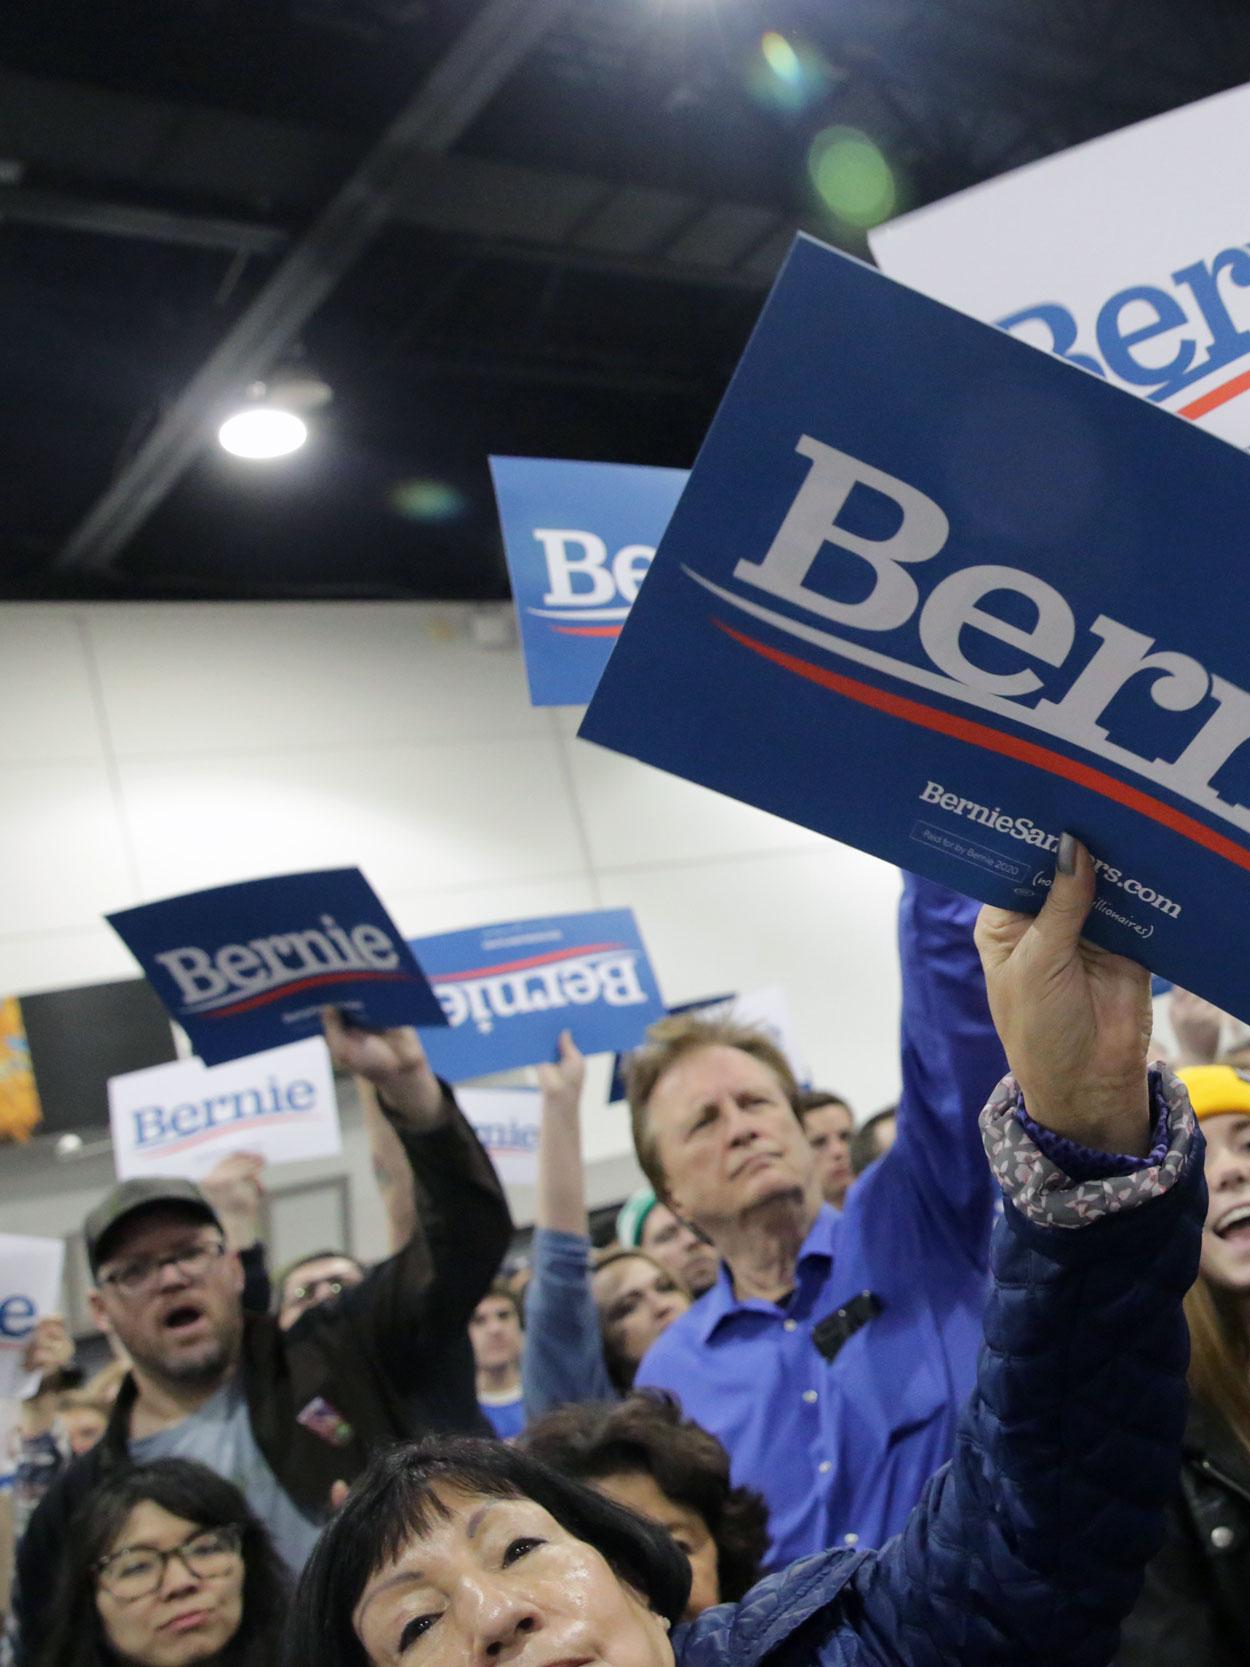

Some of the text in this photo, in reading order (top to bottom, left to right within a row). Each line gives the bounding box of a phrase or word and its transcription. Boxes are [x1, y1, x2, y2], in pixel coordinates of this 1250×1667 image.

[967, 847, 995, 866] Bernie
[994, 859, 1020, 876] 2020
[157, 913, 400, 1008] Bernie
[132, 1077, 317, 1148] Bernie
